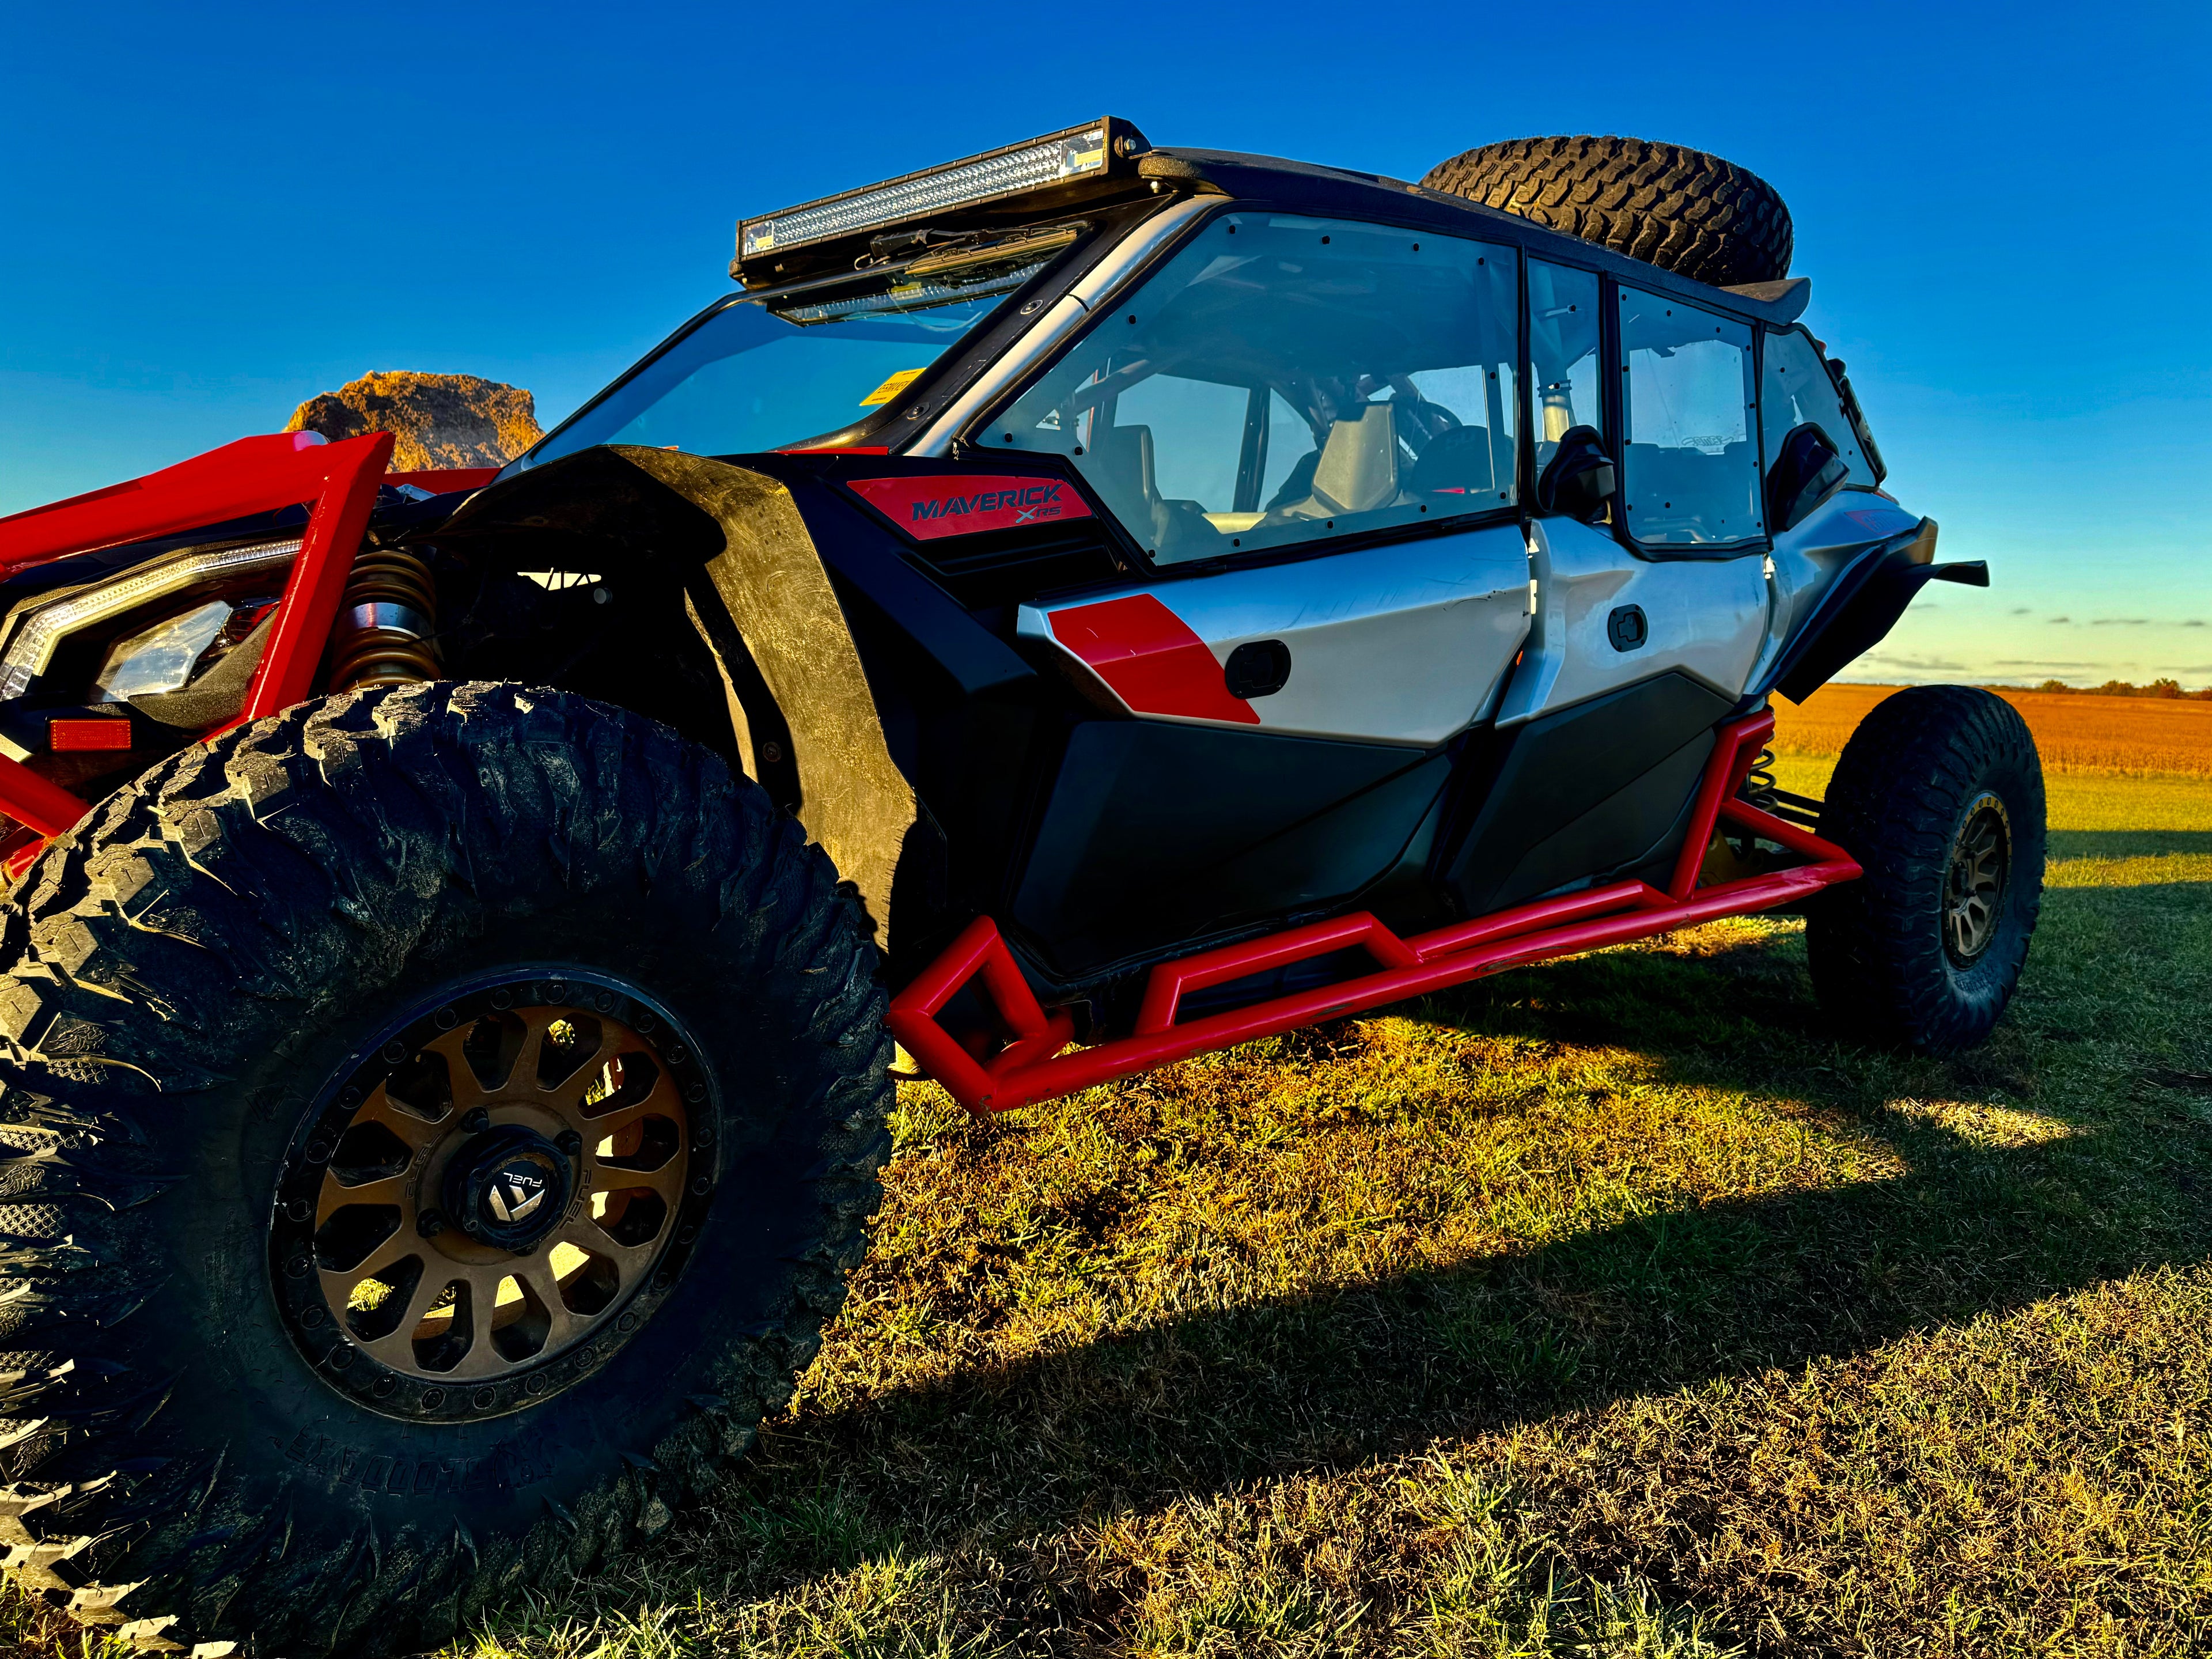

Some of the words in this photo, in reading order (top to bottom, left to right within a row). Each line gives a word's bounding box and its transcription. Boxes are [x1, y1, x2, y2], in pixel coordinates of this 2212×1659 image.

[912, 483, 1063, 521] MAVERICK
[406, 1134, 442, 1199] FUEL
[503, 1172, 543, 1187] FUEL
[559, 1169, 592, 1230] FUEL
